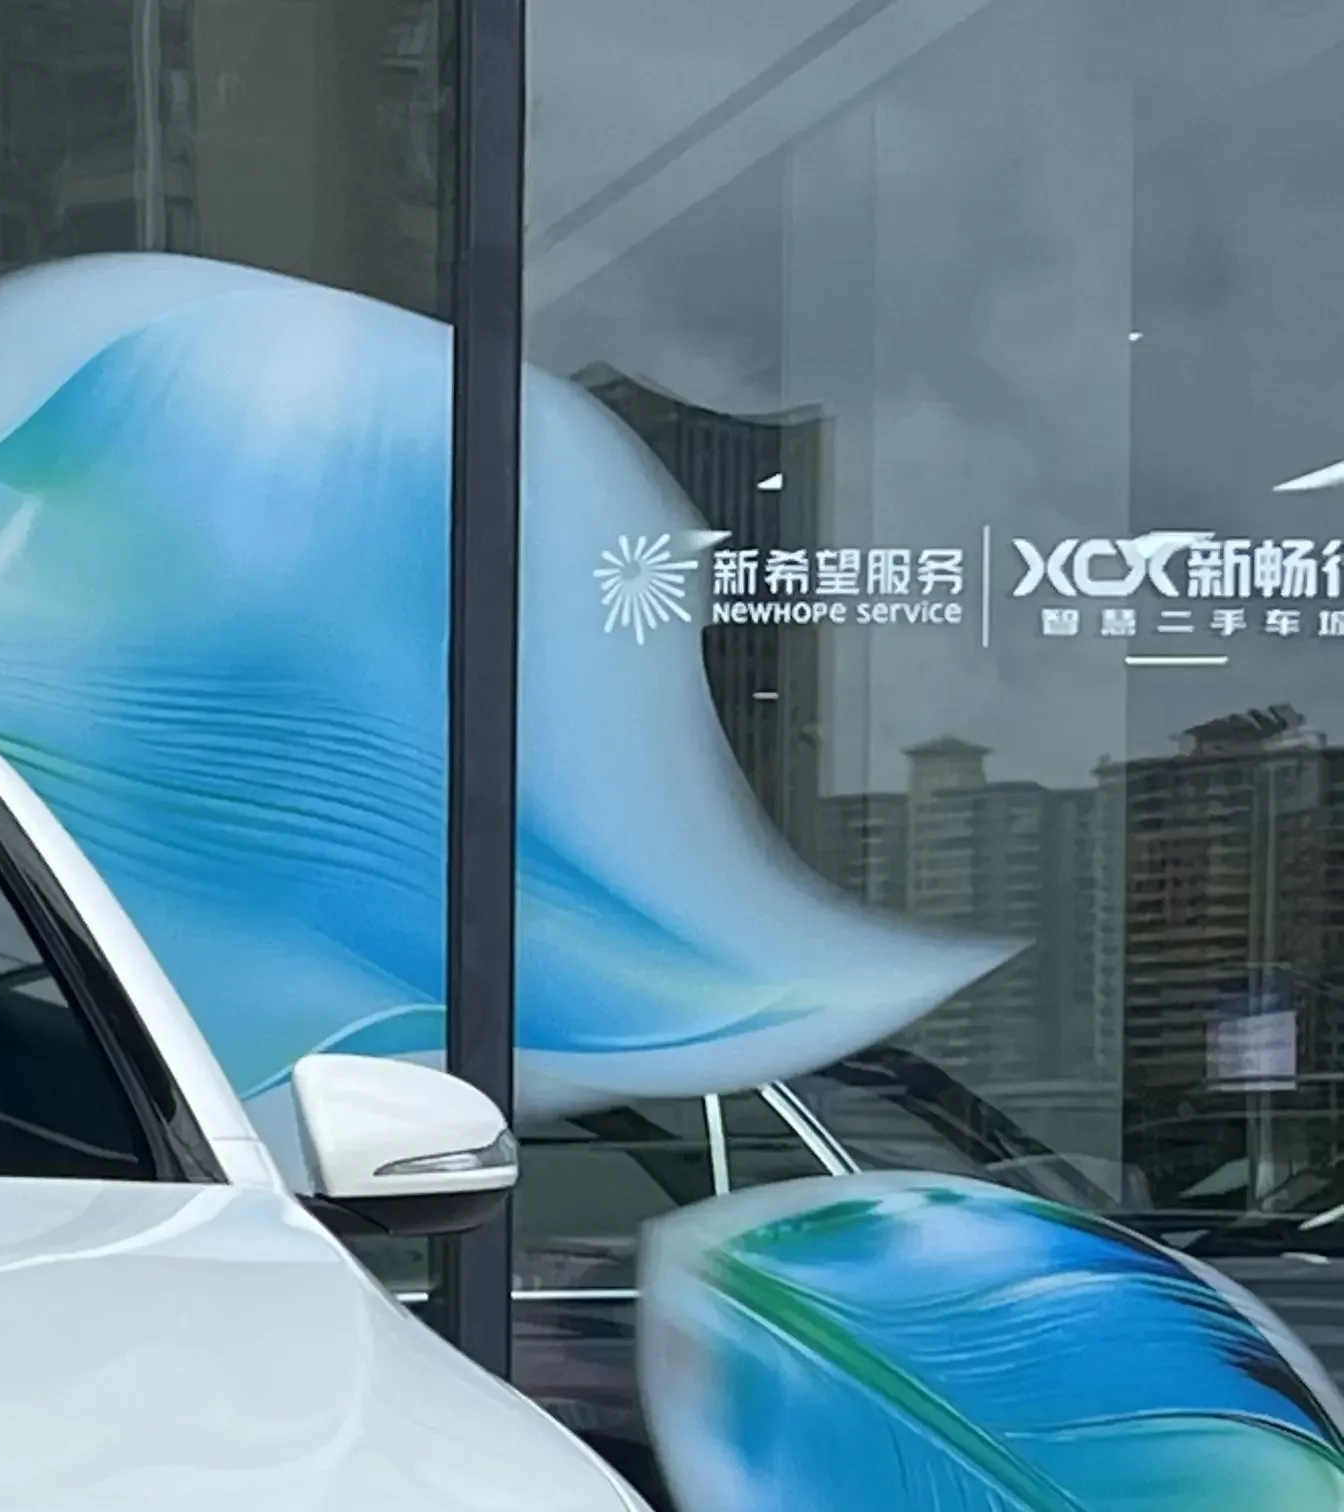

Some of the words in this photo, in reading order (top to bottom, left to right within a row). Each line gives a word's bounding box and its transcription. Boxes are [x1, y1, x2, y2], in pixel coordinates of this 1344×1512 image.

[712, 549, 964, 595] 新希望服务
